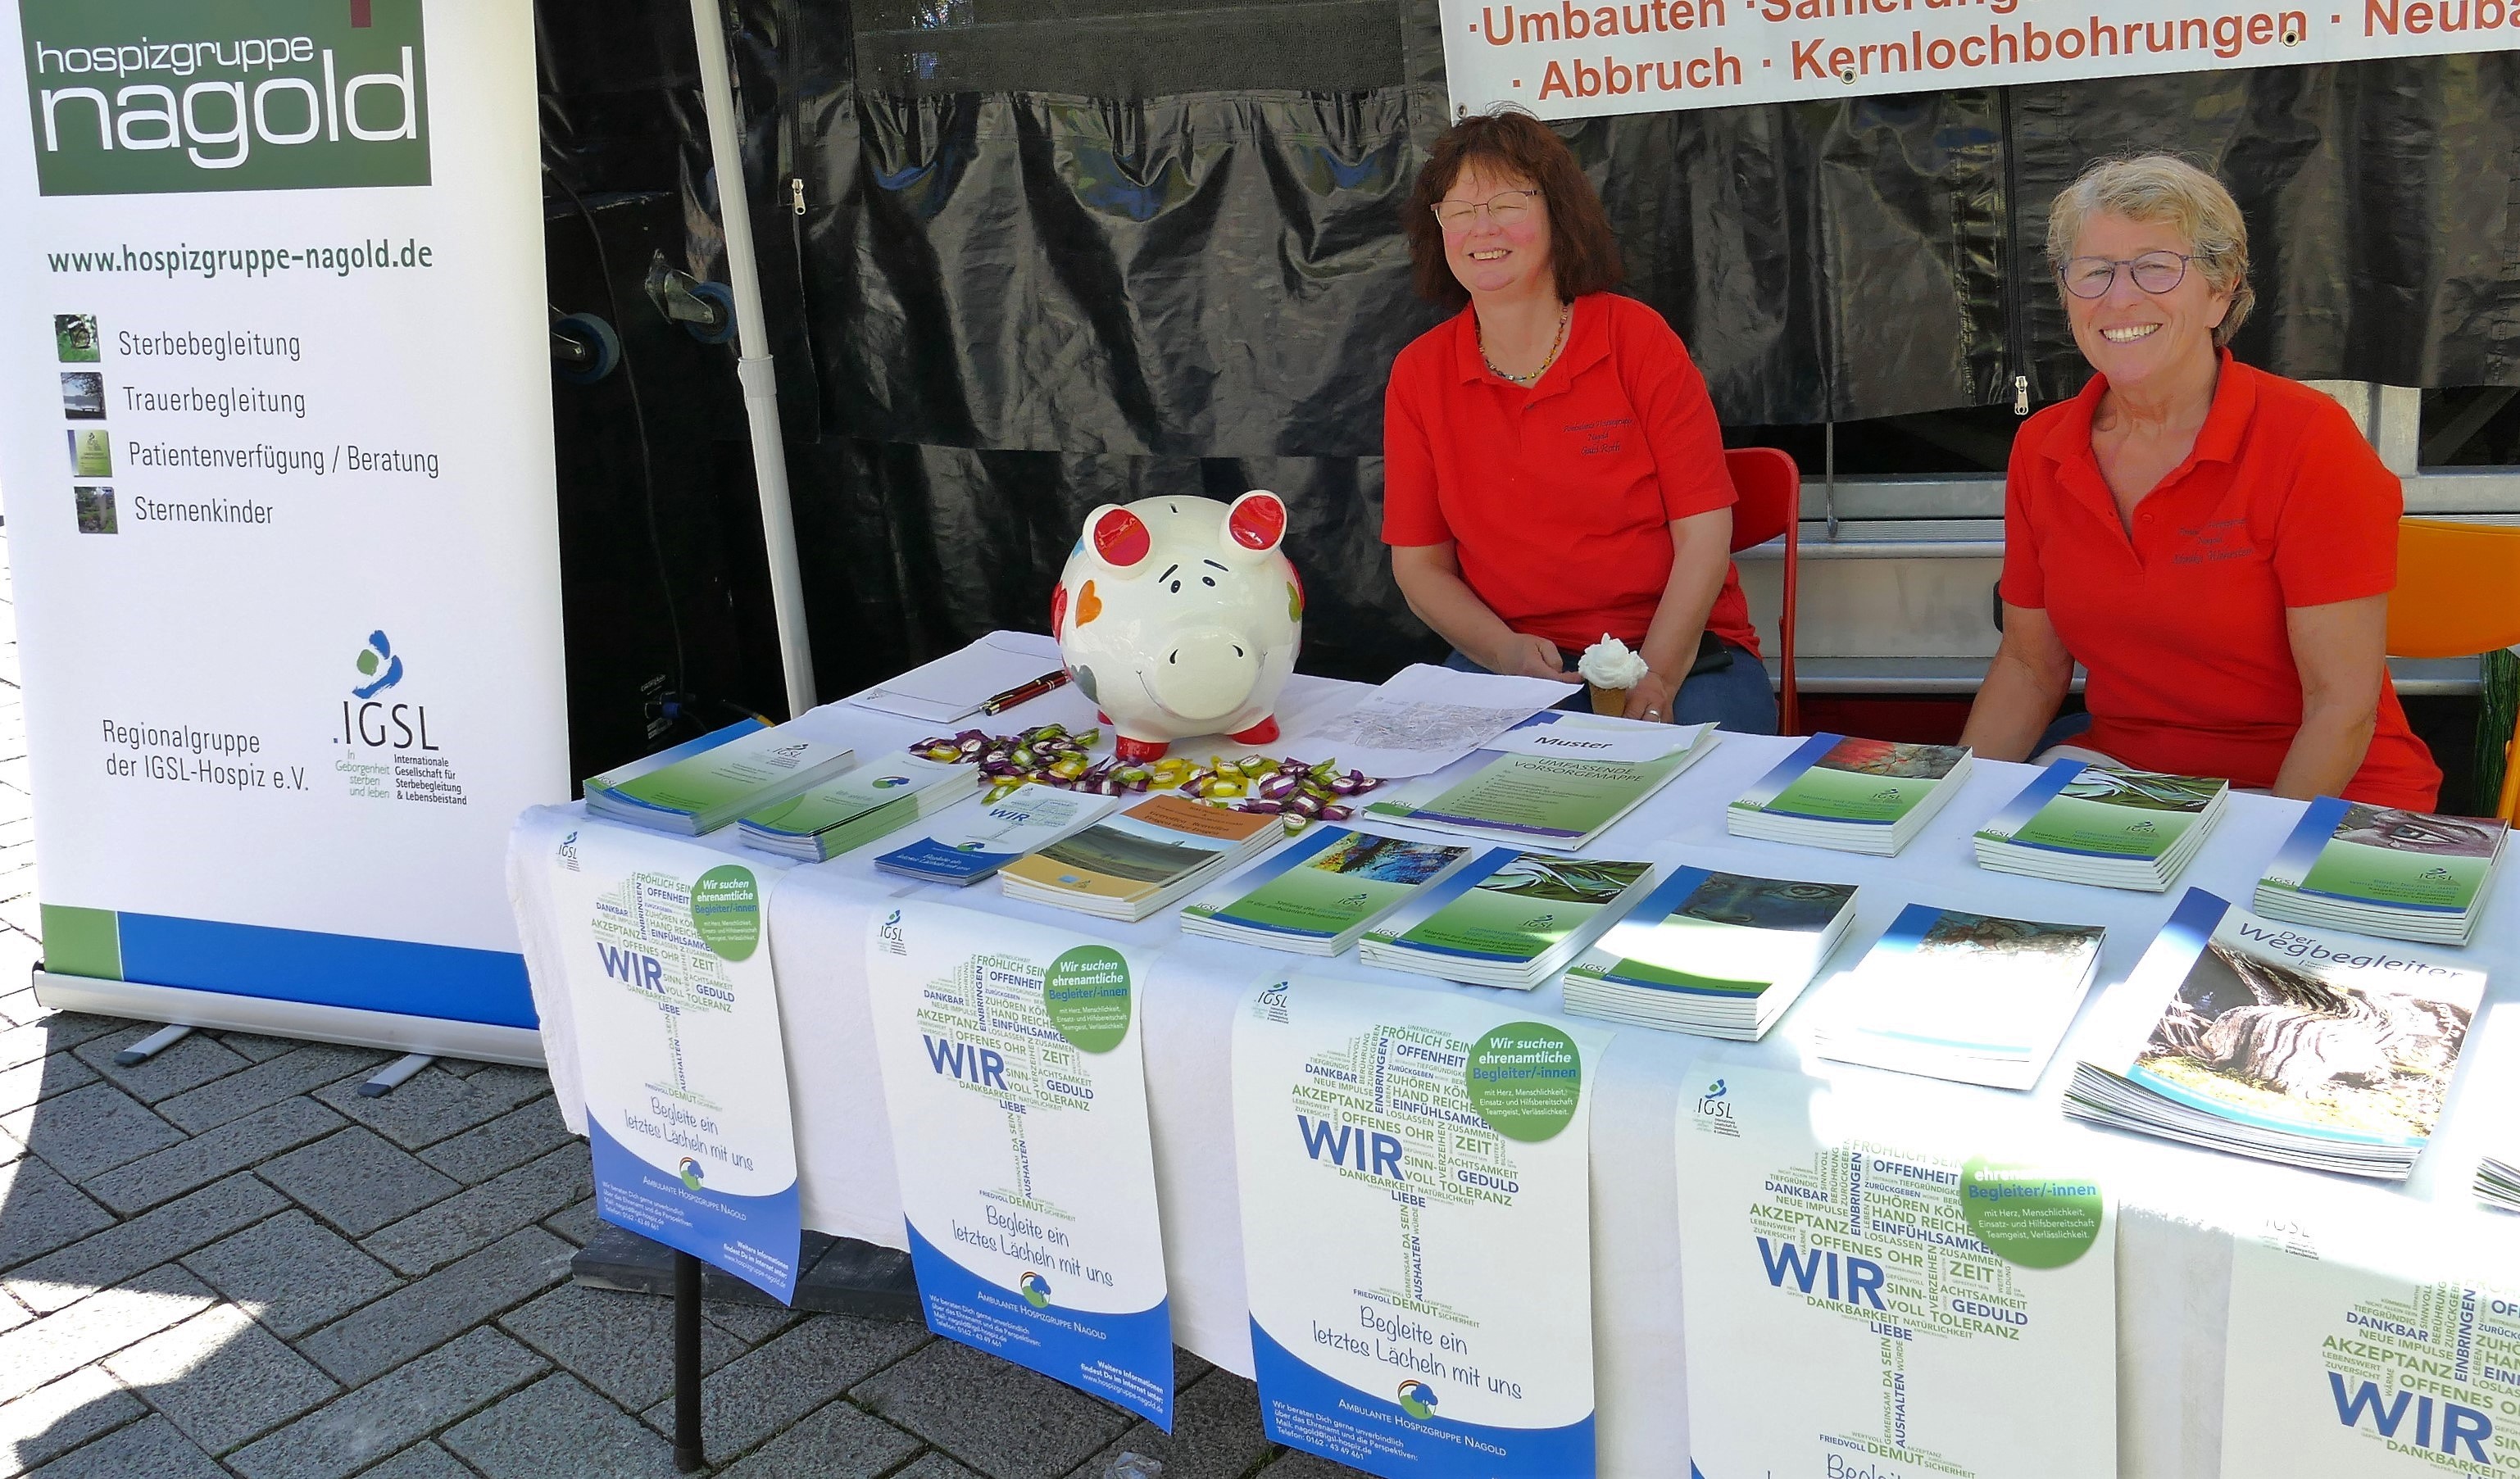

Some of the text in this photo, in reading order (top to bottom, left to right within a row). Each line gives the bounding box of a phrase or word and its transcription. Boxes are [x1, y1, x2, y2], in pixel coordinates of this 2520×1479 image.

[1482, 0, 1726, 46] Umbauten
[37, 37, 313, 78] hospizgruppe
[1538, 48, 1741, 101] Abbruch
[1791, 10, 2308, 80] Kernlochbohrungen
[40, 46, 417, 170] nagold
[48, 240, 433, 278] www.hospizgruppe-nagold.de
[119, 331, 300, 361] Sterbebegleitung
[123, 387, 306, 418] Trauerbegleitung
[129, 441, 325, 475] Patientenverfügung
[347, 446, 439, 478] Beratung
[134, 497, 272, 524] Sternenkinder
[344, 701, 438, 751] IGSL
[103, 719, 259, 757] Regionalgruppe
[1534, 737, 1613, 750] Muster
[347, 750, 356, 760] In
[394, 754, 449, 767] Internationale
[1539, 757, 1635, 774] UMFASSENDE
[107, 754, 309, 792] der IGSL-Hospiz e.V.
[335, 760, 390, 776] Geborgenheit
[395, 766, 456, 780] Gesellschaft für
[1514, 761, 1644, 782] VORSORGEMAPPE
[350, 774, 379, 787] sterben
[396, 778, 461, 794] Sterbebegleitung
[350, 787, 389, 798] und leben
[397, 791, 467, 805] & Lebensbeistand
[989, 809, 1029, 821] WIR
[703, 880, 749, 889] Wir suchen
[647, 887, 689, 905] OFFENHEIT
[697, 891, 753, 901] ehrenamtliche
[694, 905, 758, 915] Begleiter/-innen
[2280, 931, 2316, 945] Der
[2239, 923, 2464, 981] Wegbegleiter
[597, 942, 665, 994] WIR
[1060, 960, 1117, 972] Wir suchen
[990, 972, 1043, 990] OFFENHEIT
[1053, 973, 1123, 987] ehrenamtliche
[697, 985, 734, 1002] GEDULD
[924, 990, 964, 1005] DANKBAR
[1049, 987, 1128, 1001] Begleiter/-innen
[1258, 991, 1287, 1009] IGSL
[916, 1008, 978, 1030] AKZEPTANZ
[1382, 1026, 1472, 1054] FRÖHLICH SEIN
[1490, 1038, 1563, 1049] Wir suchen
[923, 1034, 1008, 1091] WIR
[1042, 1049, 1069, 1065] ZEIT
[1396, 1045, 1465, 1068] OFFENHEIT
[1479, 1052, 1571, 1064] ehrenamtliche
[1305, 1064, 1357, 1083] DANKBAR
[1375, 1038, 1388, 1114] EINBRINGEN
[1388, 1064, 1433, 1078] ZURÜCKGEBEN
[1473, 1067, 1576, 1082] Begleiter/-innen
[1047, 1079, 1093, 1099] GEDULD
[1314, 1077, 1374, 1096] NEUE IMPULSE
[1387, 1073, 1441, 1092] ZUHÖREN
[1496, 1089, 1513, 1097] Herz,
[1515, 1088, 1567, 1096] Menschlichkeit,
[1292, 1085, 1374, 1112] AKZEPTANZ
[1393, 1087, 1429, 1104] HAND
[1520, 1098, 1573, 1106] Hilfsbereitschaft
[651, 1096, 718, 1134] Begleite ein
[1000, 1100, 1026, 1114] LIEBE
[1486, 1109, 1519, 1117] Teamgeist,
[1698, 1097, 1733, 1119] IGSL
[1342, 1112, 1434, 1141] OFFENES OHR
[1387, 1110, 1434, 1127] LOSLASSEN
[624, 1109, 754, 1172] letztes Lächeln mit uns
[1447, 1123, 1499, 1141] ZUSAMMEN
[1297, 1114, 1405, 1181] WIR
[1438, 1121, 1446, 1178] VERZEIHEN
[1455, 1136, 1492, 1155] ZEIT
[1405, 1155, 1437, 1171] SINN-
[1448, 1158, 1519, 1179] ACHTSAMKEIT
[1873, 1160, 1958, 1186] OFFENHEIT
[1339, 1168, 1414, 1192] DANKBARKEIT
[1405, 1170, 1435, 1186] VOLL
[1458, 1170, 1519, 1193] GEDULD
[1392, 1191, 1426, 1208] LIEBE
[1419, 1186, 1474, 1206] NATÜRLICHKEIT
[1441, 1181, 1512, 1206] TOLERANZ
[1765, 1181, 1828, 1204] DANKBAR
[1850, 1152, 1861, 1236] EINBRINGEN
[1968, 1183, 2096, 1199] Begleiter/-innen
[987, 1205, 1069, 1247] Begleite ein
[1401, 1205, 1410, 1249] DA SEIN
[1750, 1204, 1849, 1234] AKZEPTANZ
[953, 1219, 1113, 1286] letztes Lächeln mit uns
[1411, 1236, 1423, 1301] AUSHALTEN
[1756, 1236, 1887, 1311] WIR
[1950, 1261, 1994, 1283] ZEIT
[1354, 1288, 1391, 1304] FRIEDVOLL
[1392, 1295, 1438, 1317] DEMUT
[1941, 1285, 2027, 1310] ACHTSAMKEIT
[1438, 1312, 1480, 1328] SICHERHEIT
[1807, 1295, 1899, 1324] DANKBARKEIT
[1952, 1300, 2027, 1325] GEDULD
[1360, 1305, 1468, 1354] Begleite ein
[1870, 1322, 1912, 1341] LIEBE
[1931, 1311, 2019, 1341] TOLERANZ
[2346, 1312, 2428, 1342] DANKBAR
[2455, 1289, 2476, 1382] EINBRINGEN
[2359, 1328, 2454, 1360] NEUE IMPULSE
[1313, 1320, 1522, 1400] letztes Lächeln mit uns
[2322, 1335, 2453, 1379] AKZEPTANZ
[1276, 1418, 1292, 1428] Mail:
[1338, 1399, 1506, 1456] AMBULANTE HOSPIZGRUPPE NAGOLD
[2327, 1371, 2493, 1465] WIR
[1277, 1427, 1324, 1446] Telefon: 0162
[1868, 1441, 1923, 1466] DEMUT
